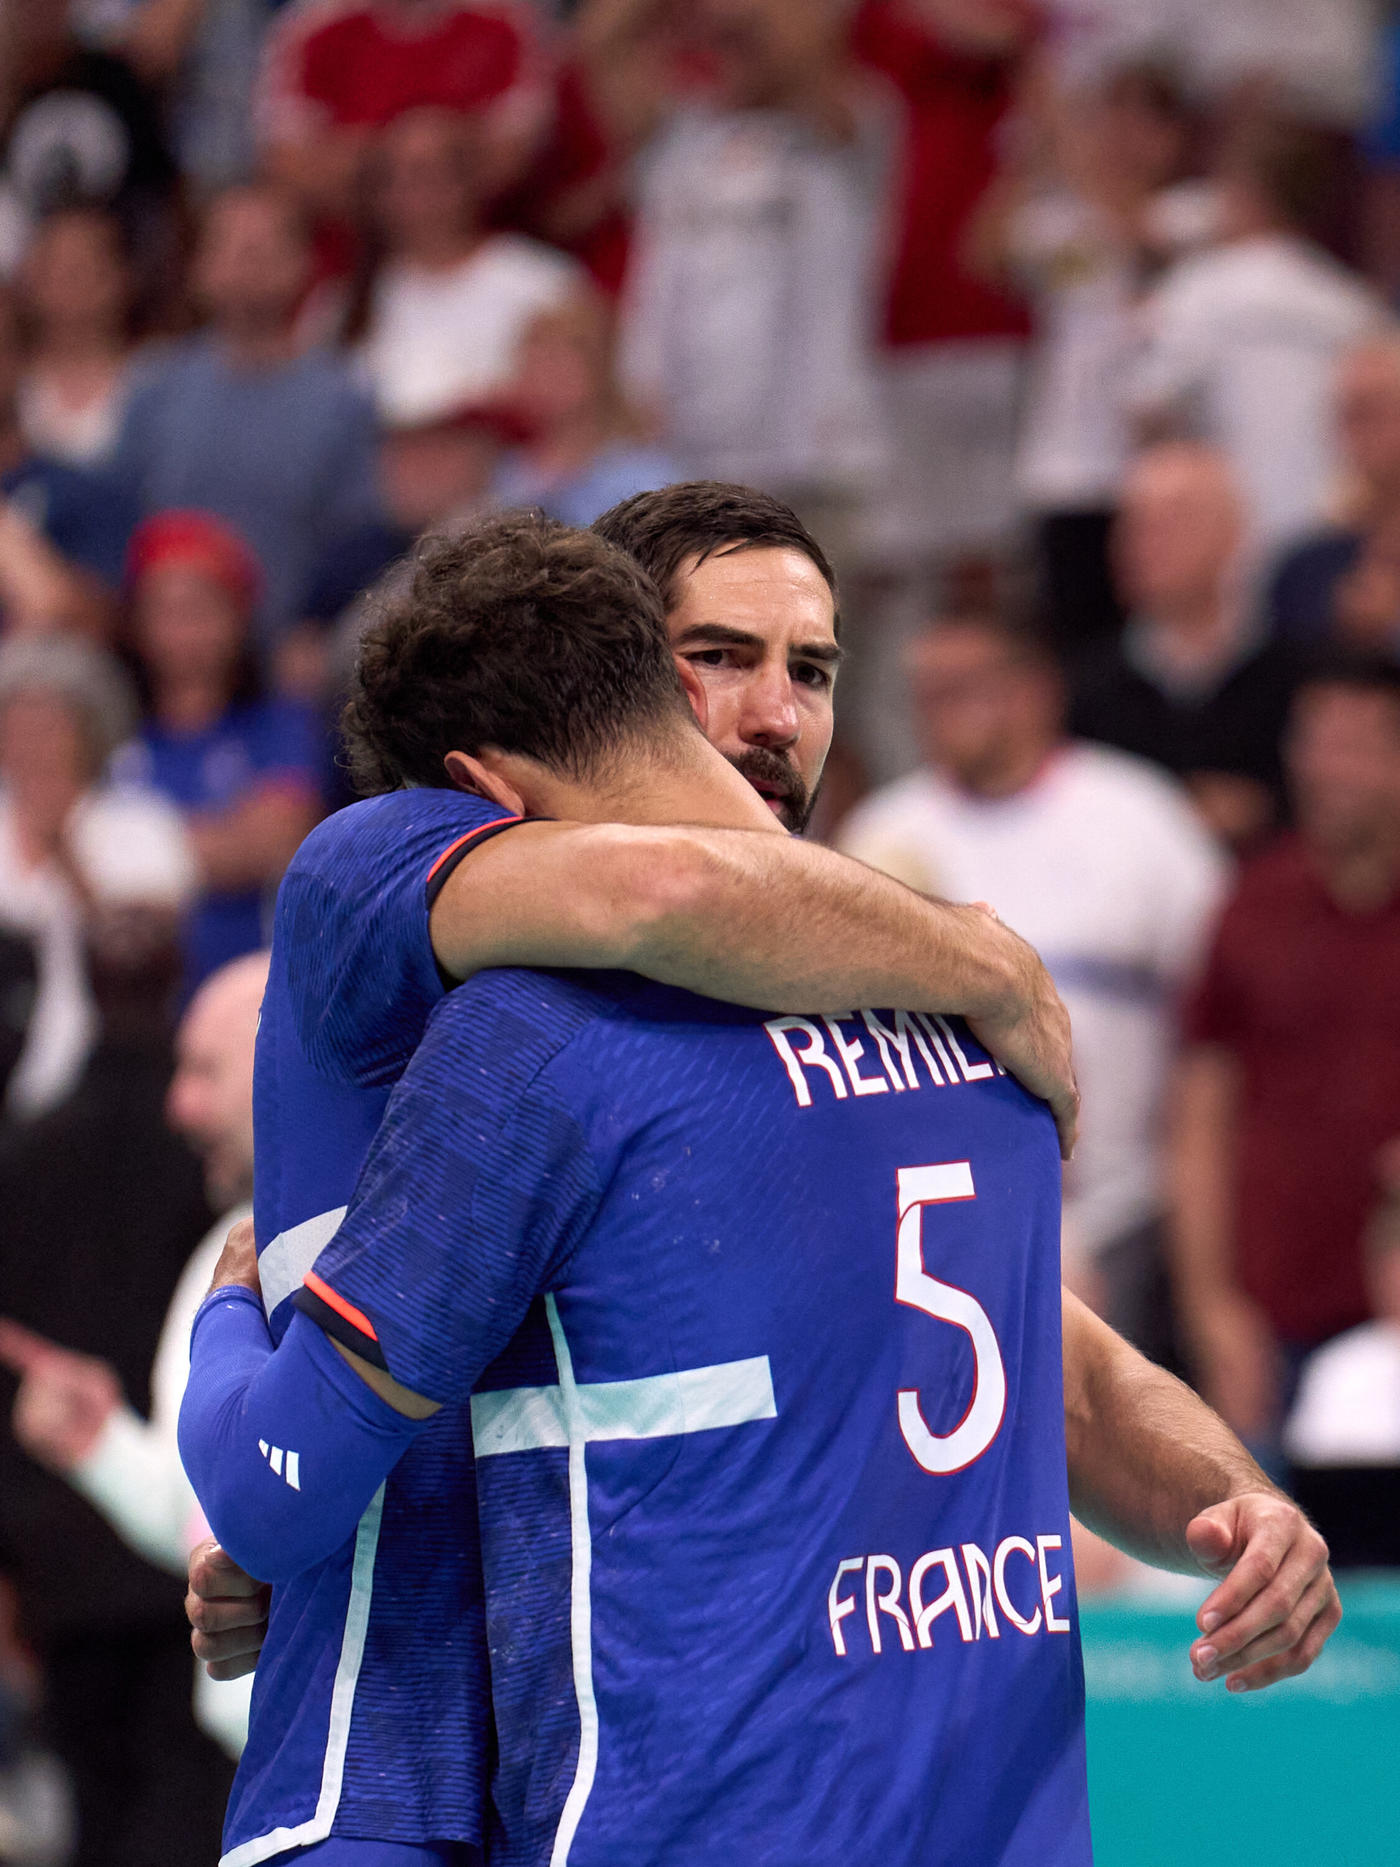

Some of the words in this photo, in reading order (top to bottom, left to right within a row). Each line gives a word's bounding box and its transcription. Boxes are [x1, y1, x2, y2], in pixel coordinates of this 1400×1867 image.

[762, 1008, 1007, 1107] REMIL
[895, 1160, 1006, 1475] 5
[828, 1534, 1071, 1656] FRANCE
